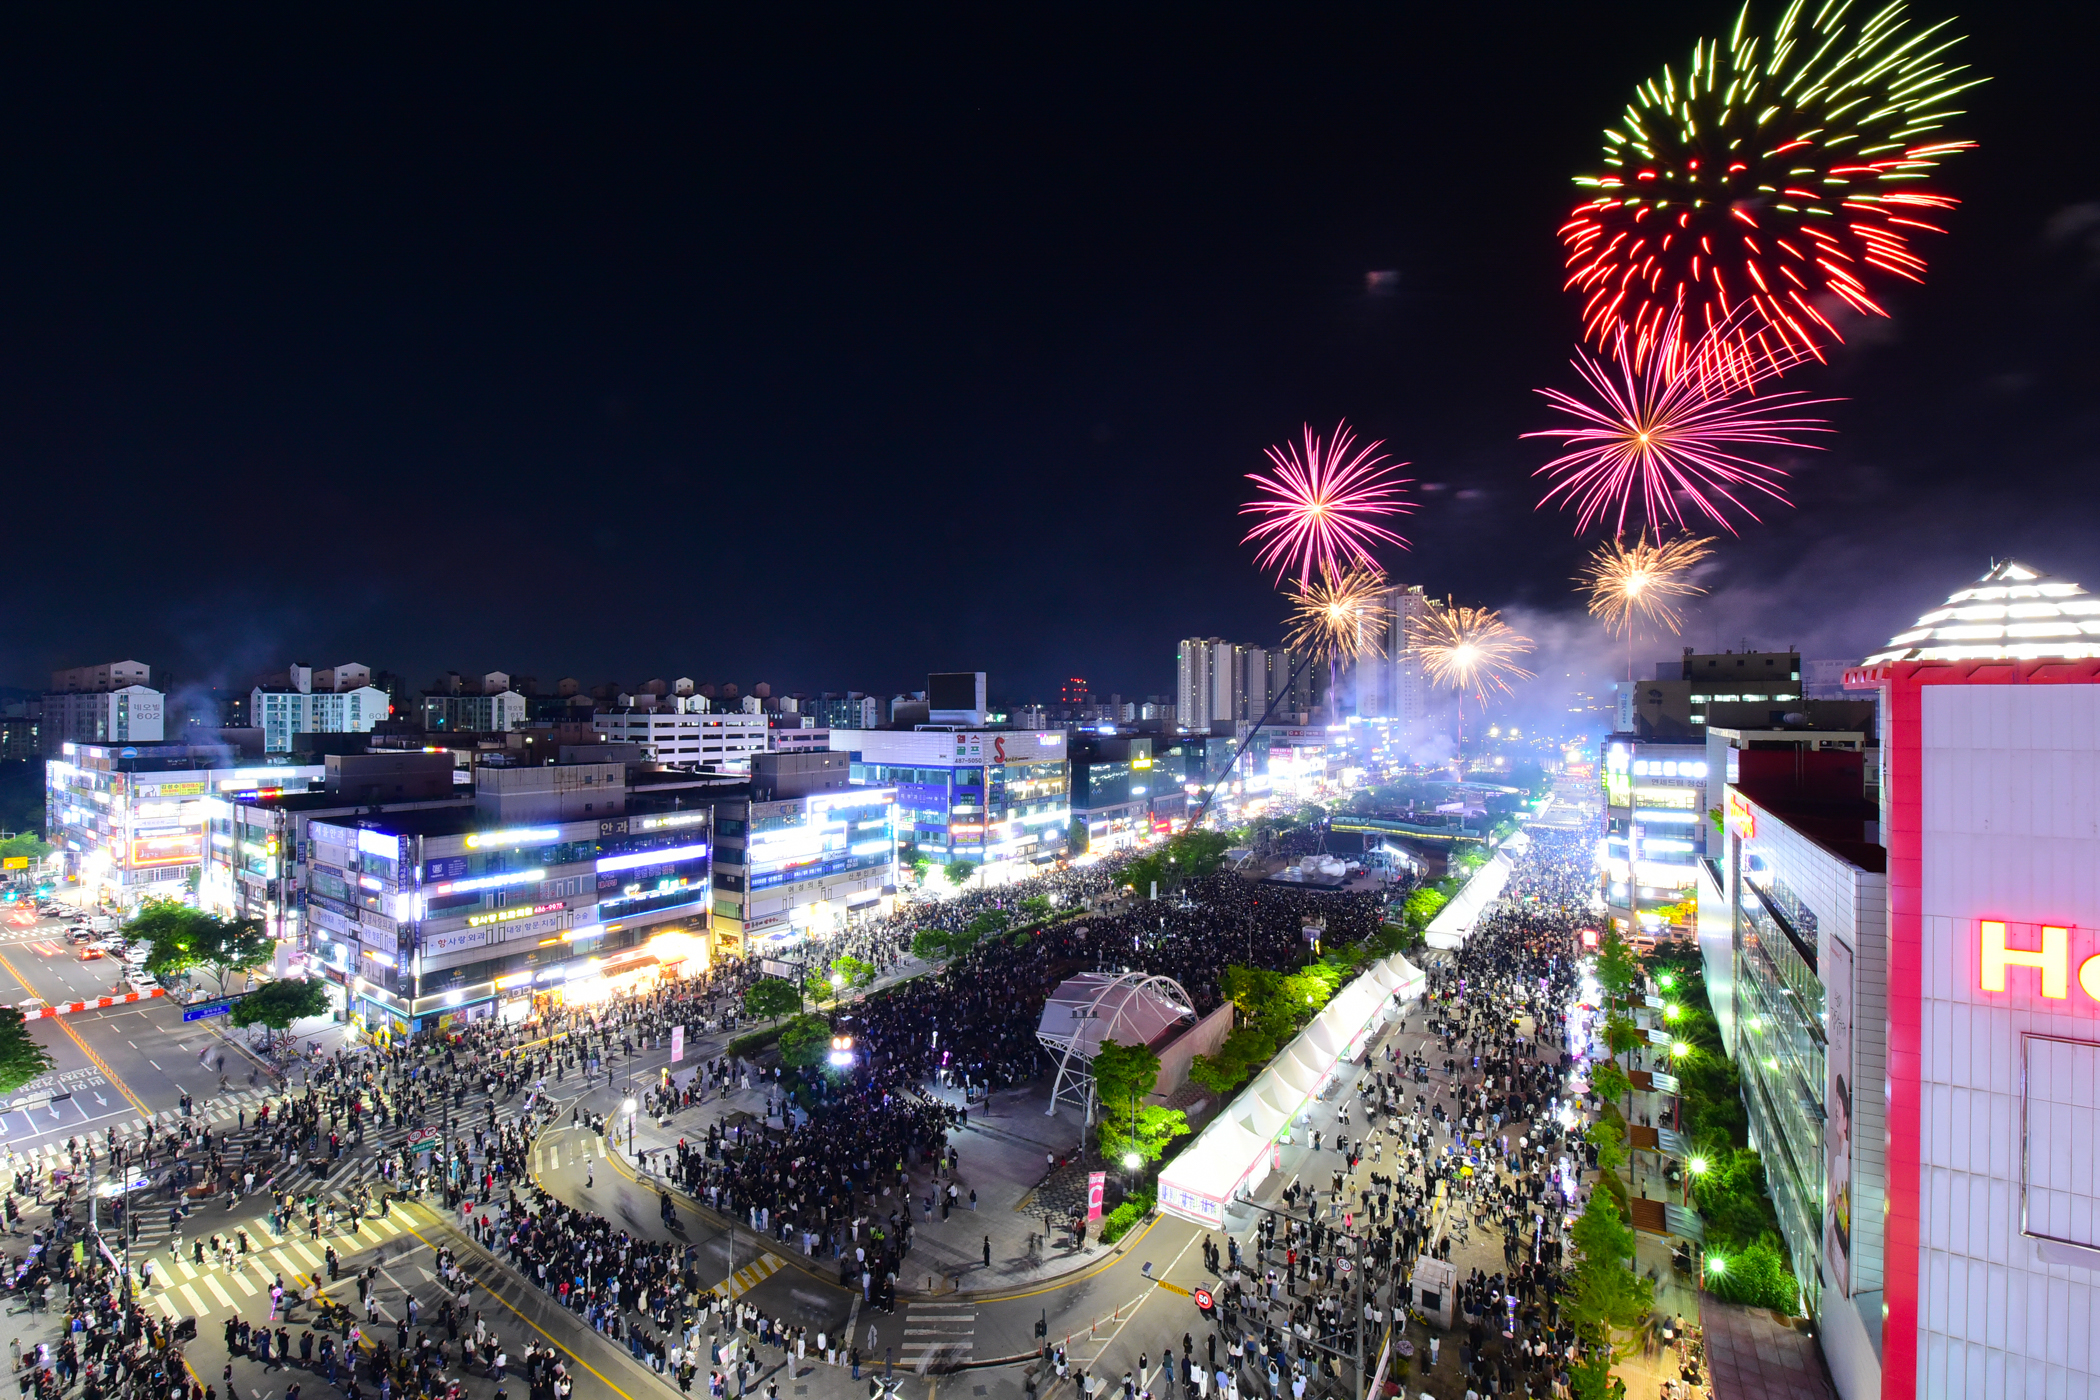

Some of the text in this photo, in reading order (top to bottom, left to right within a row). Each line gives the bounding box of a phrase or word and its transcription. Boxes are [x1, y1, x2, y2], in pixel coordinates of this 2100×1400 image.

[133, 703, 160, 711] 네오빌
[136, 712, 160, 720] 602
[368, 712, 387, 720] 601
[957, 734, 980, 743] 헬스
[957, 746, 980, 756] 골프
[1651, 779, 1684, 787] 연세드림
[315, 825, 345, 841] 서울안과
[600, 821, 629, 836] 안과
[848, 868, 877, 881] 산부인과
[788, 880, 824, 894] 여성의원
[534, 902, 564, 914] 486-9975
[437, 911, 589, 948] 항사랑외과 대장 항문 치질 수술
[411, 1132, 421, 1140] 50
[1089, 1184, 1103, 1208] C
[1340, 1260, 1350, 1270] 50
[1198, 1294, 1209, 1305] 50
